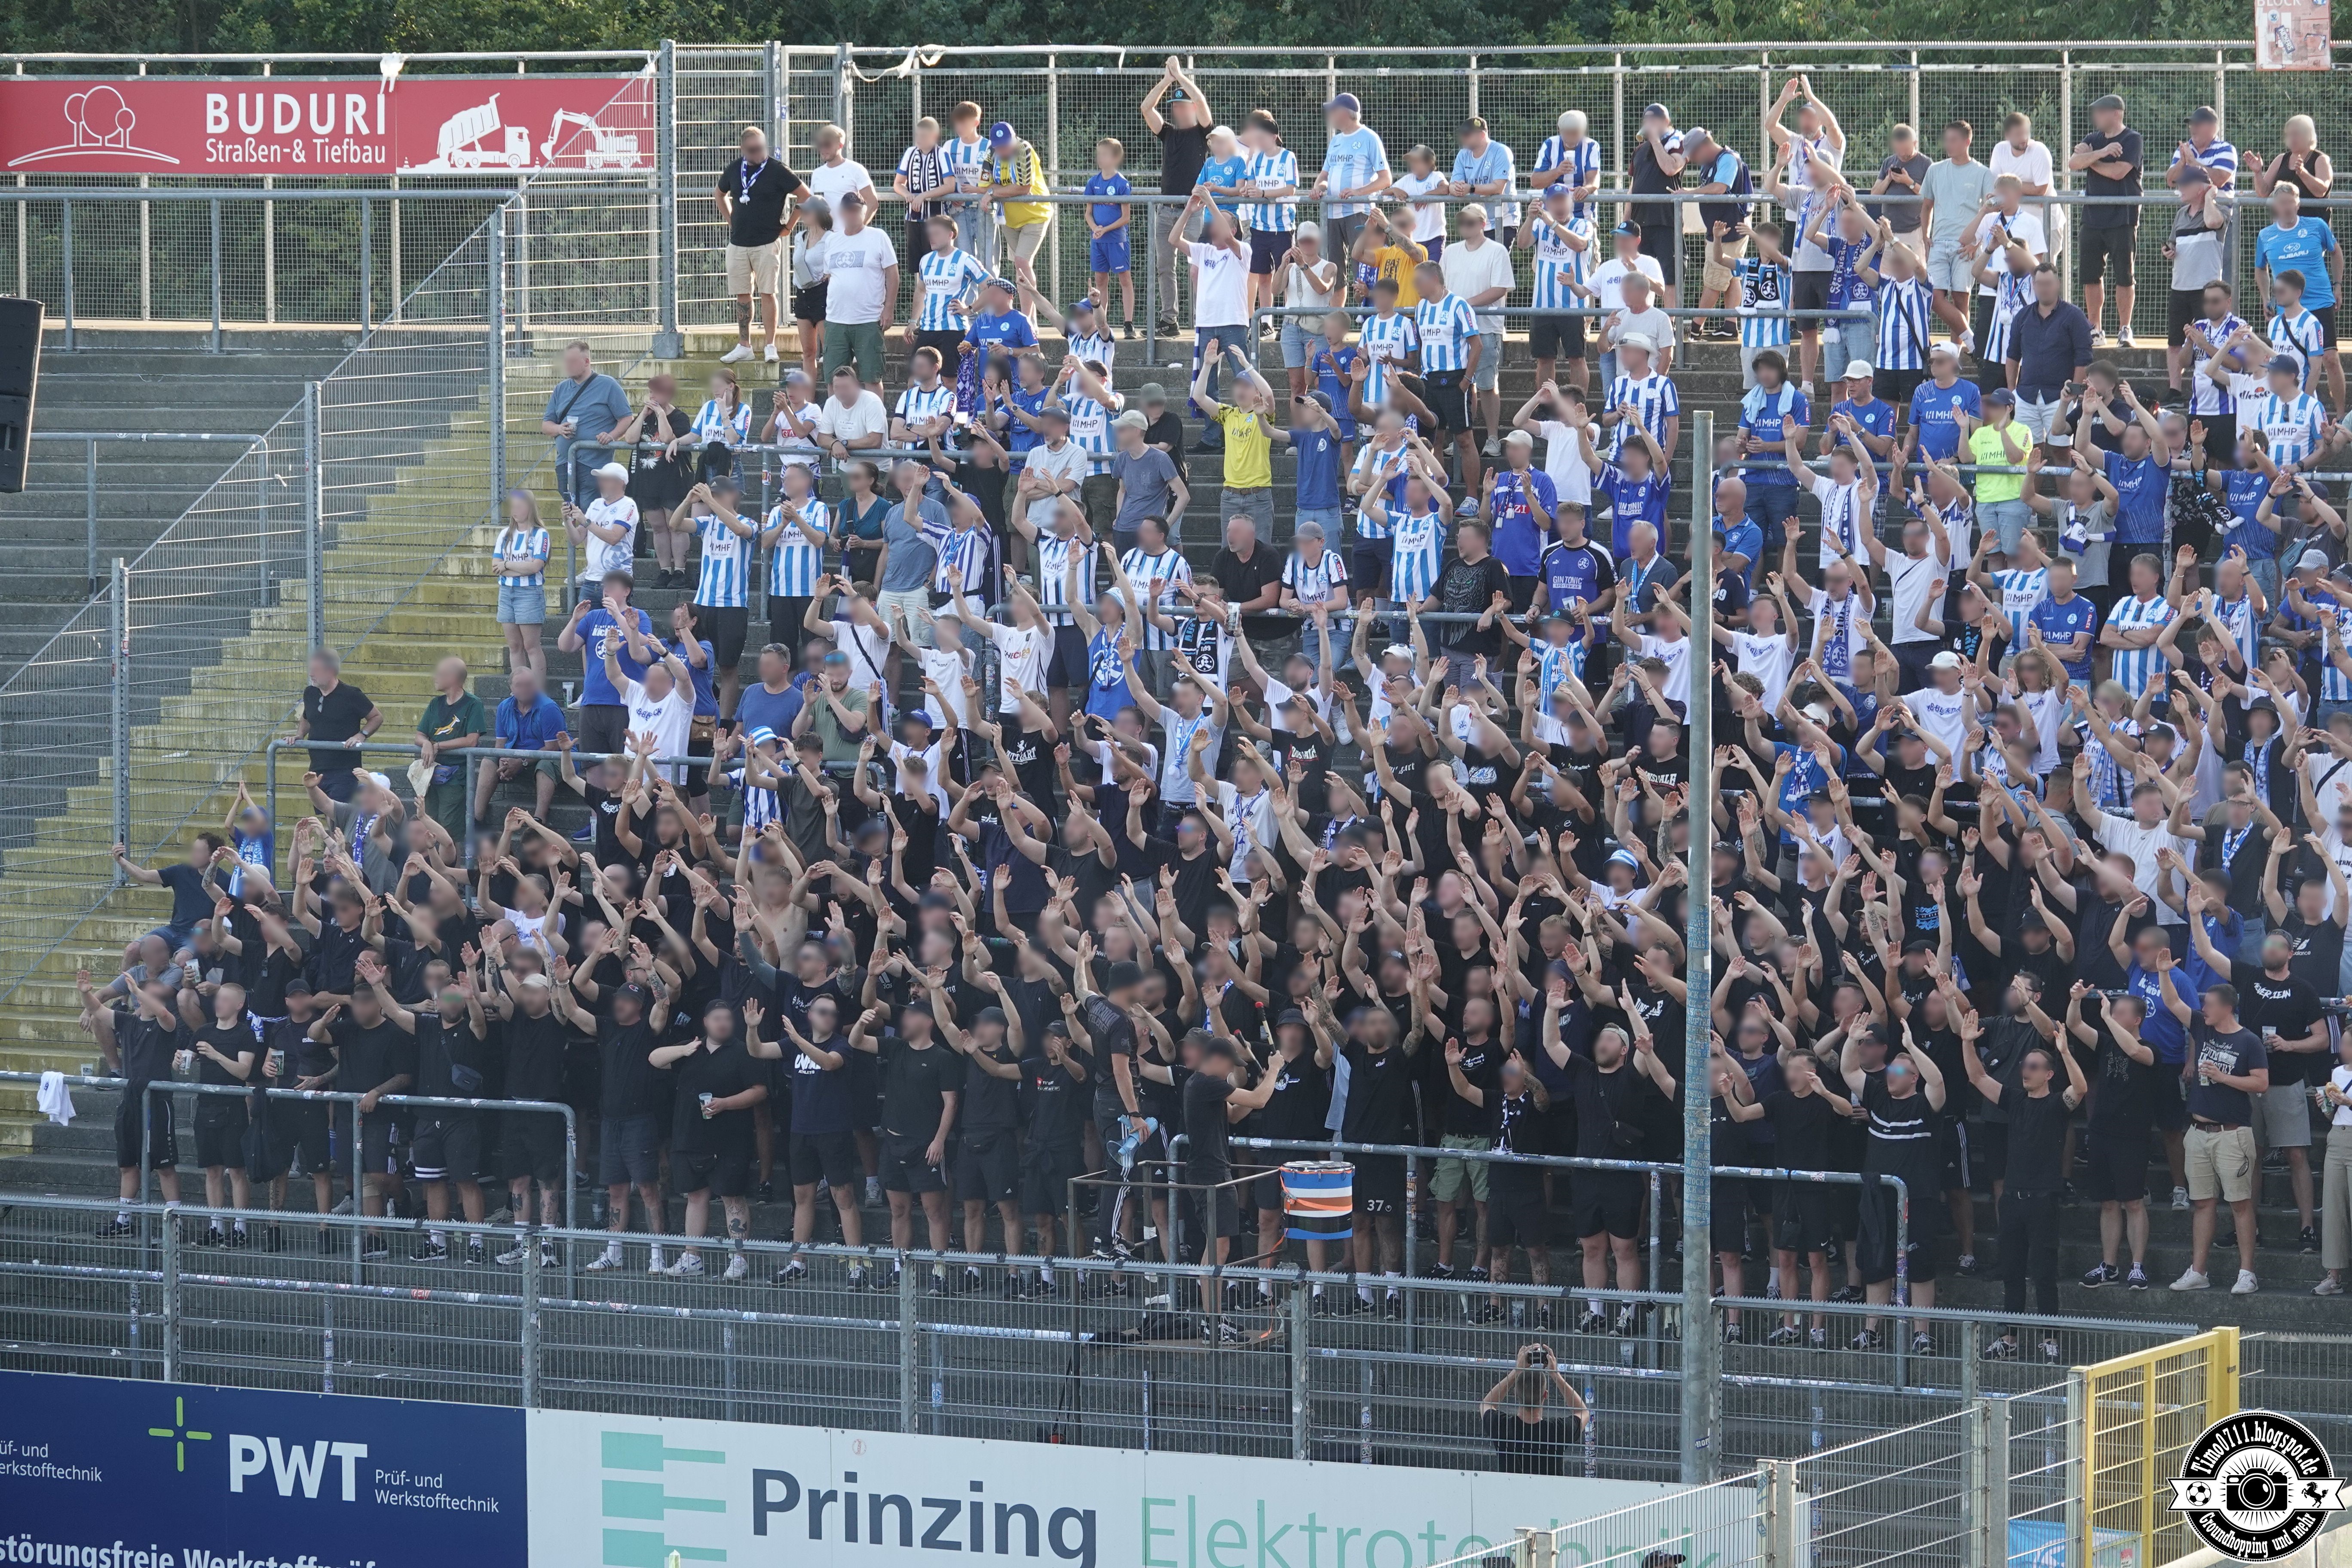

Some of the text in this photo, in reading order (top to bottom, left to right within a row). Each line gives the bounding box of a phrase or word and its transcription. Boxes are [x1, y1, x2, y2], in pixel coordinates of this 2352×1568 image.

[207, 93, 385, 135] BUDURI
[313, 138, 385, 163] Tiefbau
[1551, 248, 1567, 256] MHP
[1081, 420, 1098, 428] MHP
[1239, 429, 1251, 437] MHP
[2124, 476, 2142, 489] MHP
[2239, 493, 2256, 501] MHP
[1553, 576, 1582, 585] GIN TONIC
[2052, 632, 2071, 640] MHP
[1367, 1200, 1384, 1211] 37
[22, 1443, 48, 1458] und
[230, 1434, 368, 1502] PWT
[375, 1469, 443, 1488] Prüf- und
[375, 1489, 499, 1513] Werkstofftechnik
[752, 1468, 1097, 1568] Prinzing
